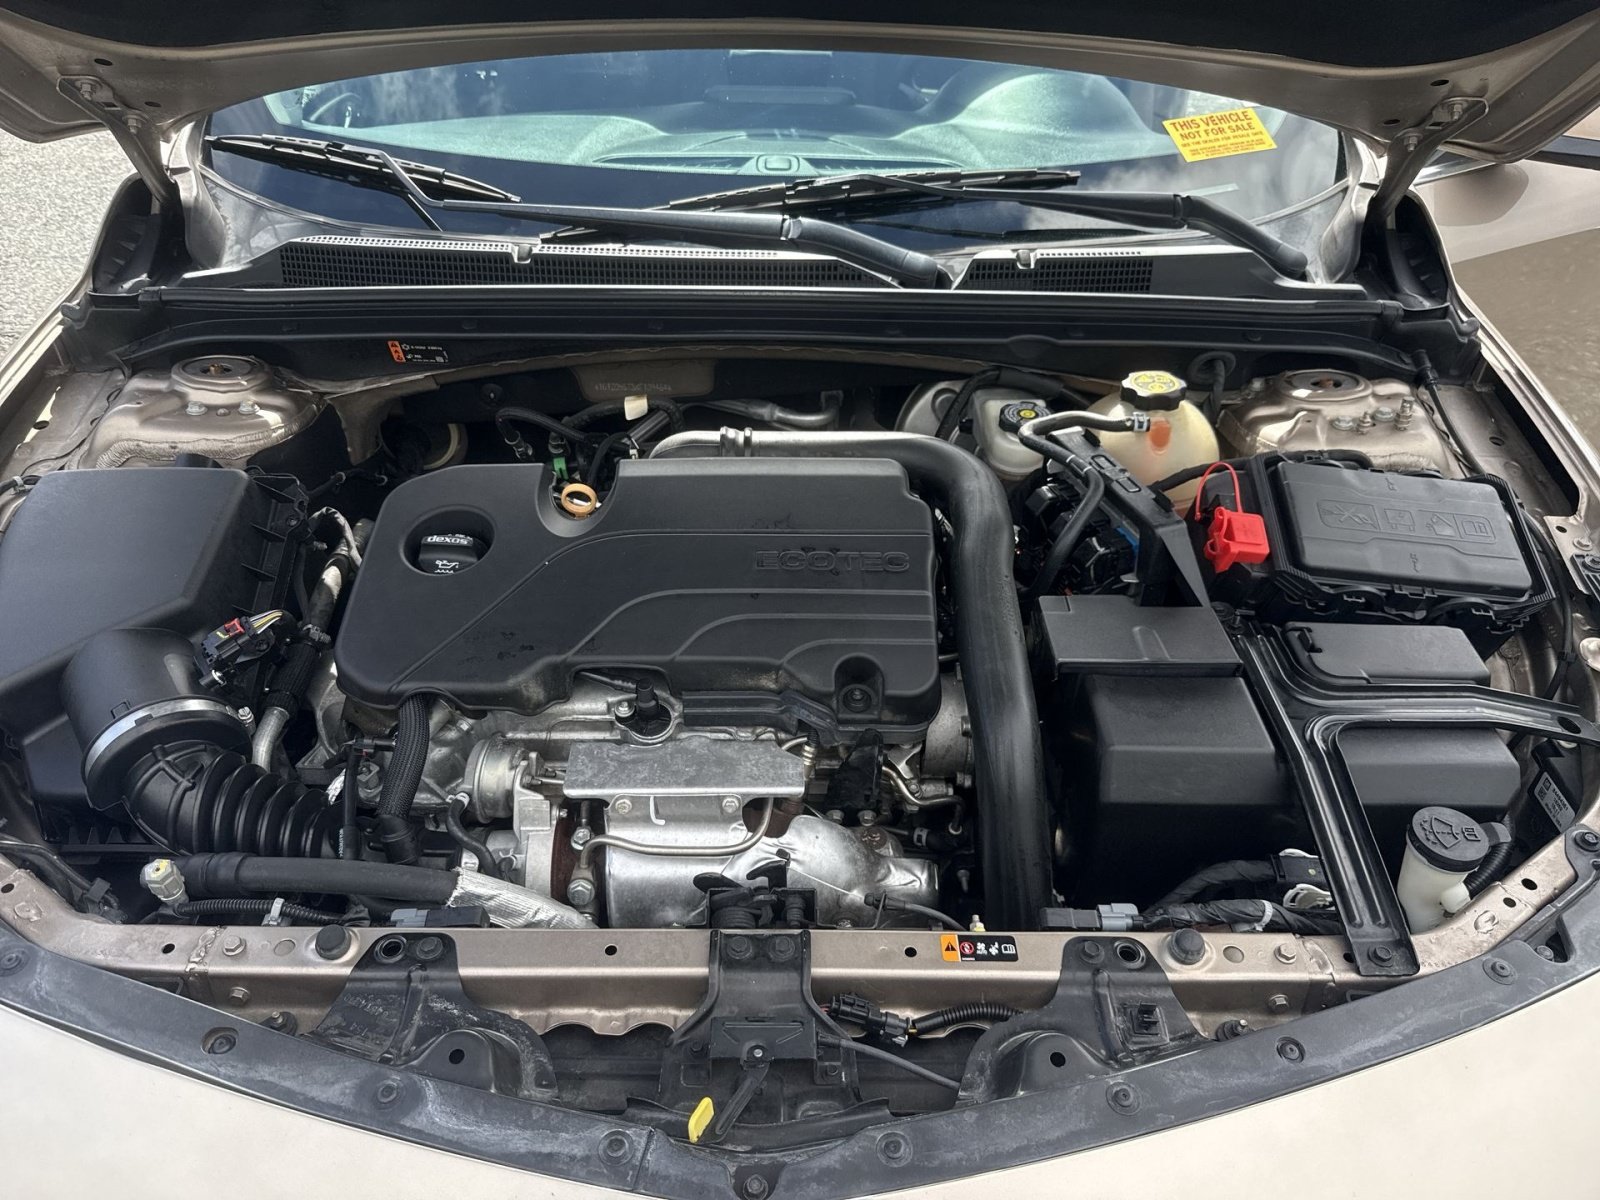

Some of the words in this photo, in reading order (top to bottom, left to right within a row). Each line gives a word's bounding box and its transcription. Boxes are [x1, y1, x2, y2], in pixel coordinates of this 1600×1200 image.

[1170, 118, 1200, 132] THIS
[1200, 111, 1252, 126] VEHICLE
[1180, 131, 1202, 141] NOT
[1205, 128, 1226, 137] FOR
[1228, 122, 1255, 133] SALE
[427, 535, 468, 545] dexos
[756, 551, 910, 572] ECOTEC
